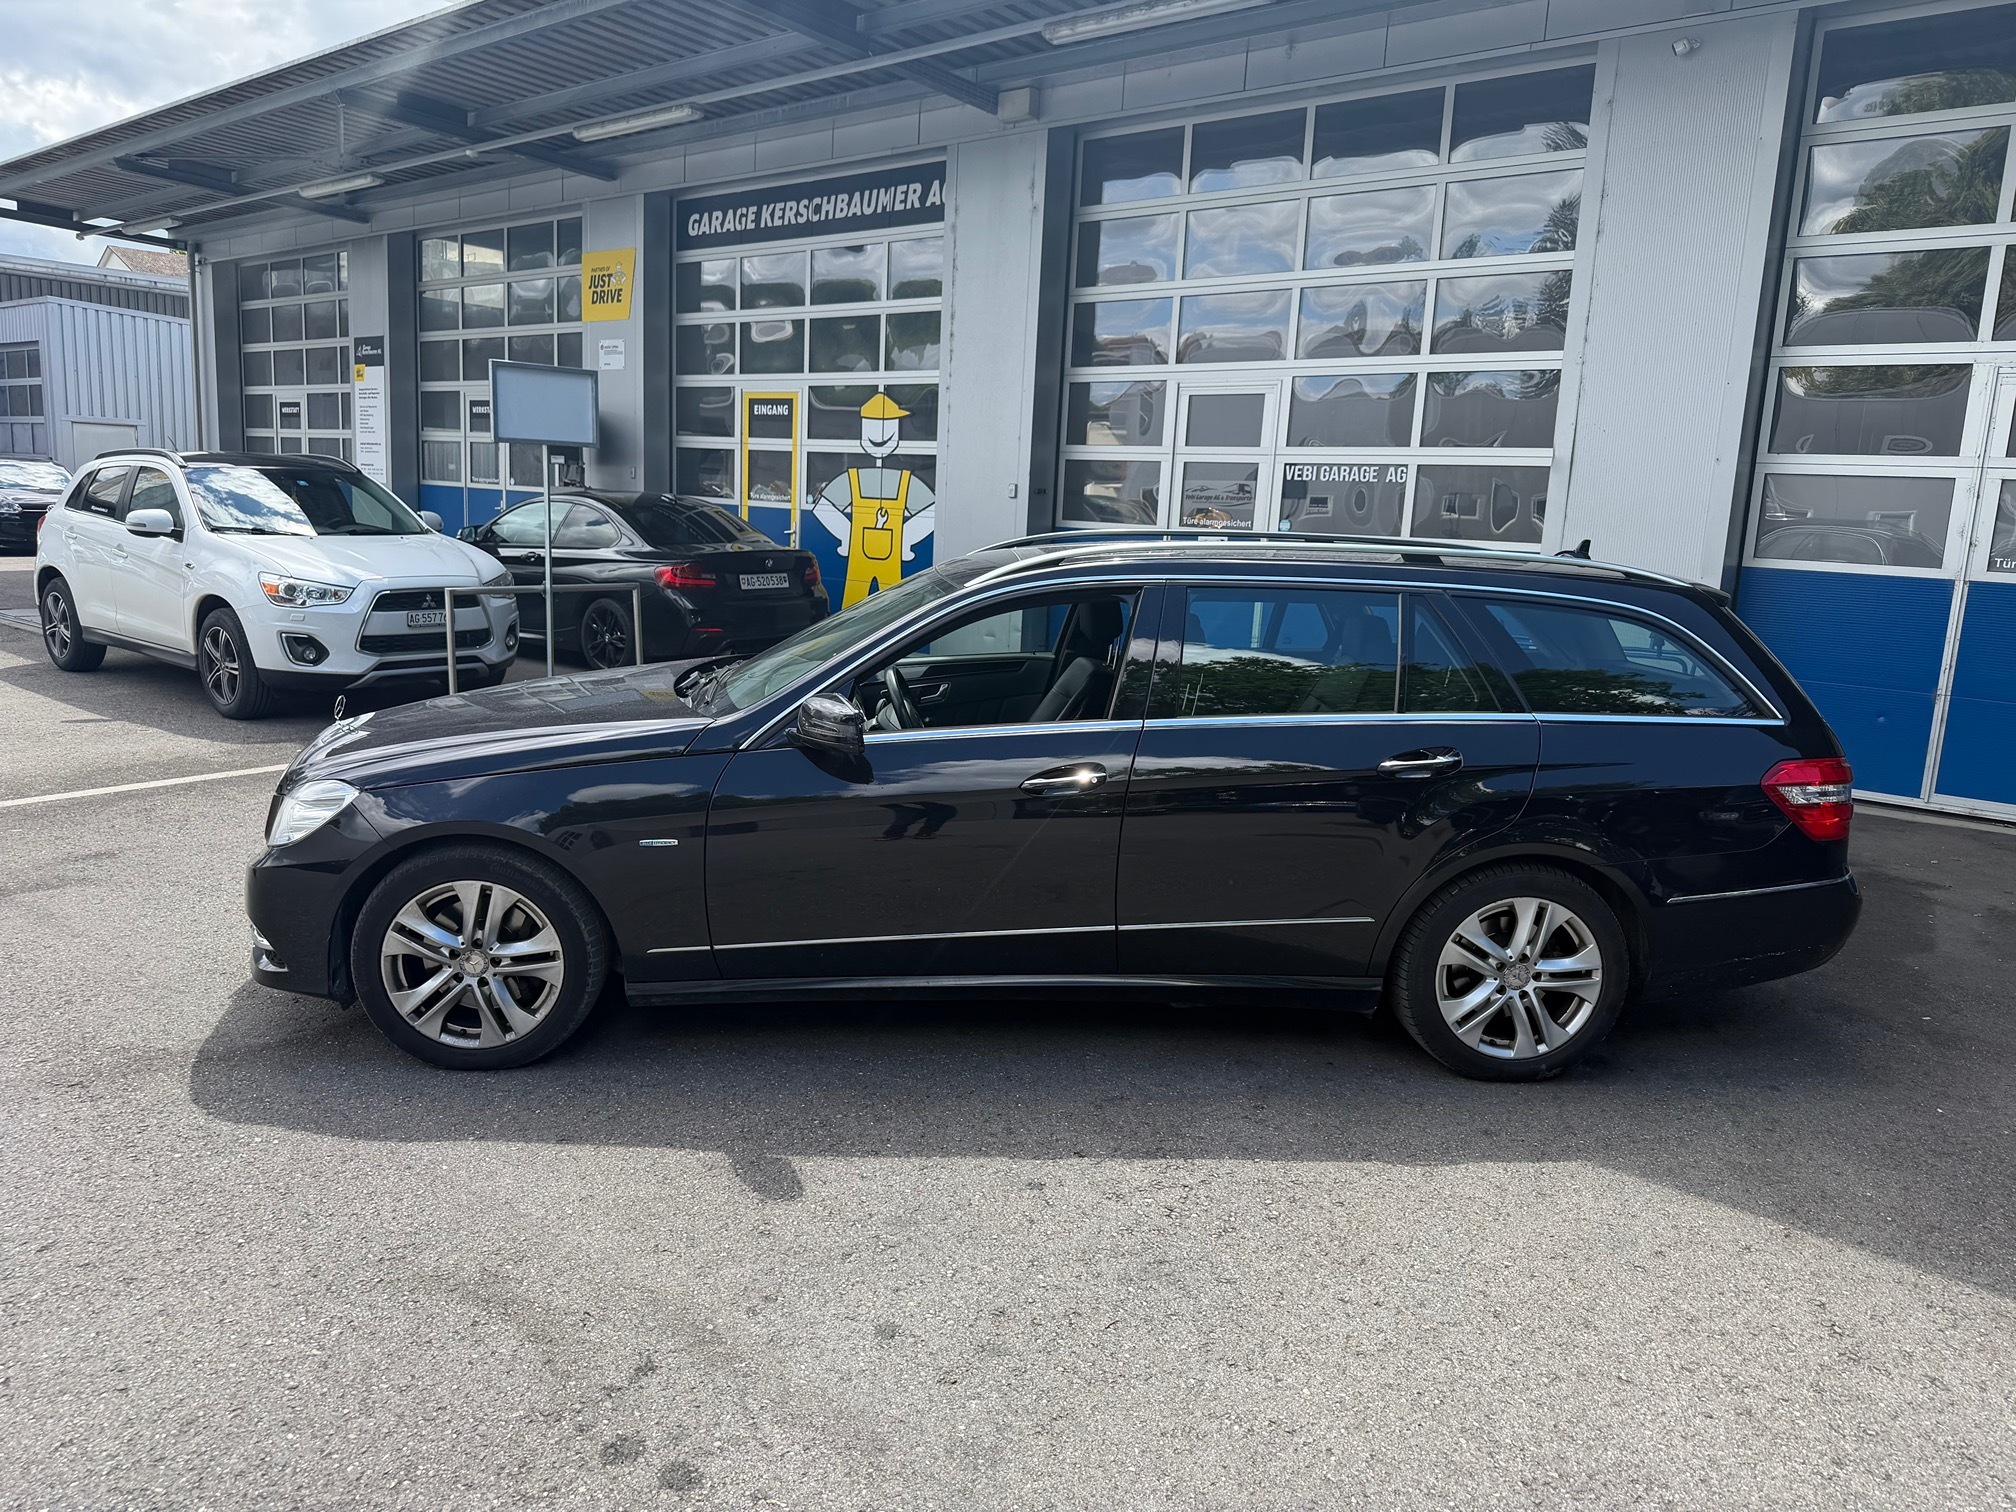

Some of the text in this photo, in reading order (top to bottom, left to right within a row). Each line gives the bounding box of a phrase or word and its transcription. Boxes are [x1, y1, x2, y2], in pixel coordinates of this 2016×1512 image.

[687, 179, 946, 237] GARAGE KERSCHBAUMER A
[588, 273, 613, 290] JUST
[591, 288, 623, 305] DRIVE
[753, 404, 789, 416] EINGANG
[1285, 465, 1407, 483] VEBI GARAGE AG
[1199, 517, 1252, 528] alarmgesichert
